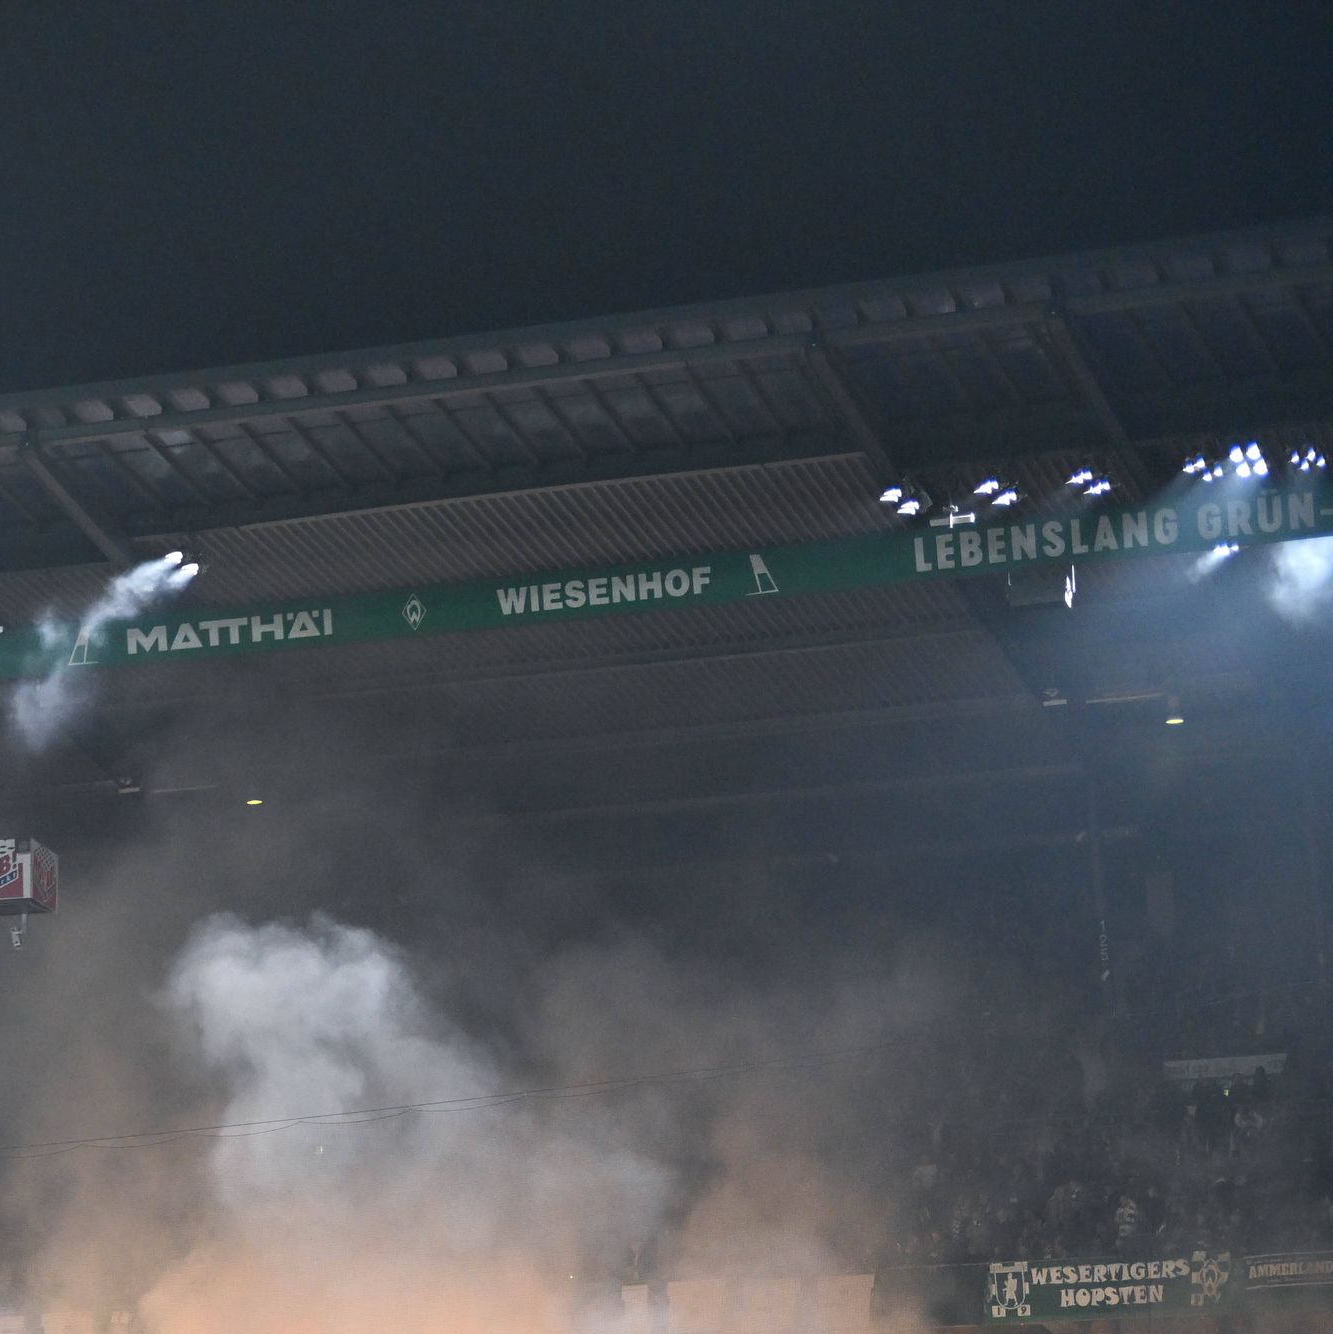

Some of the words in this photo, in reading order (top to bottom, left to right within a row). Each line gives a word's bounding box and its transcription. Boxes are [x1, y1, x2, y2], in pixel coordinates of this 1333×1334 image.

[913, 508, 1180, 573] LEBENSLANG
[496, 566, 712, 616] WIESENHOF
[126, 608, 333, 655] MATTHÄI
[1031, 1258, 1191, 1286] WESERTIGERS
[1060, 1284, 1165, 1308] HOPSTEN
